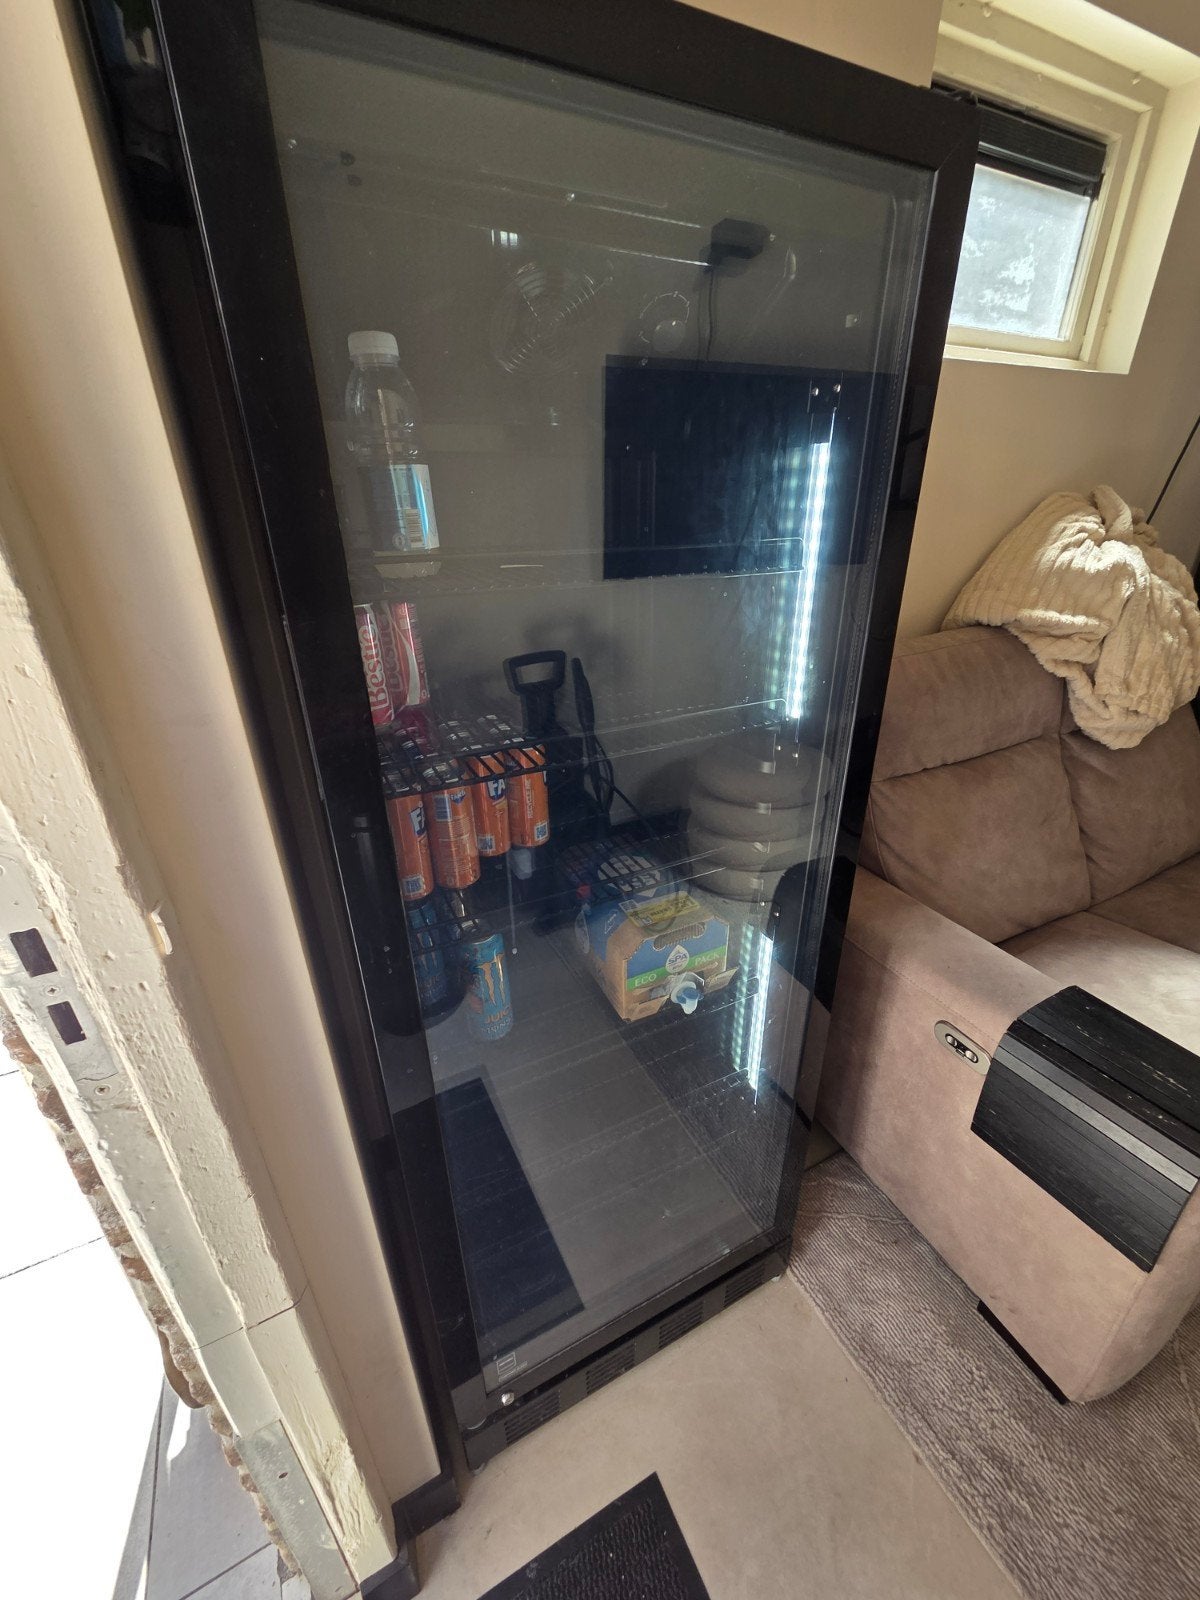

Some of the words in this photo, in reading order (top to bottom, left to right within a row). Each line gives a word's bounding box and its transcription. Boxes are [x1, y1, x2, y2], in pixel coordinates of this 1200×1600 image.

[358, 626, 389, 709] Bestie
[634, 973, 657, 987] ECO
[694, 952, 720, 966] PACK
[668, 953, 688, 965] SPA
